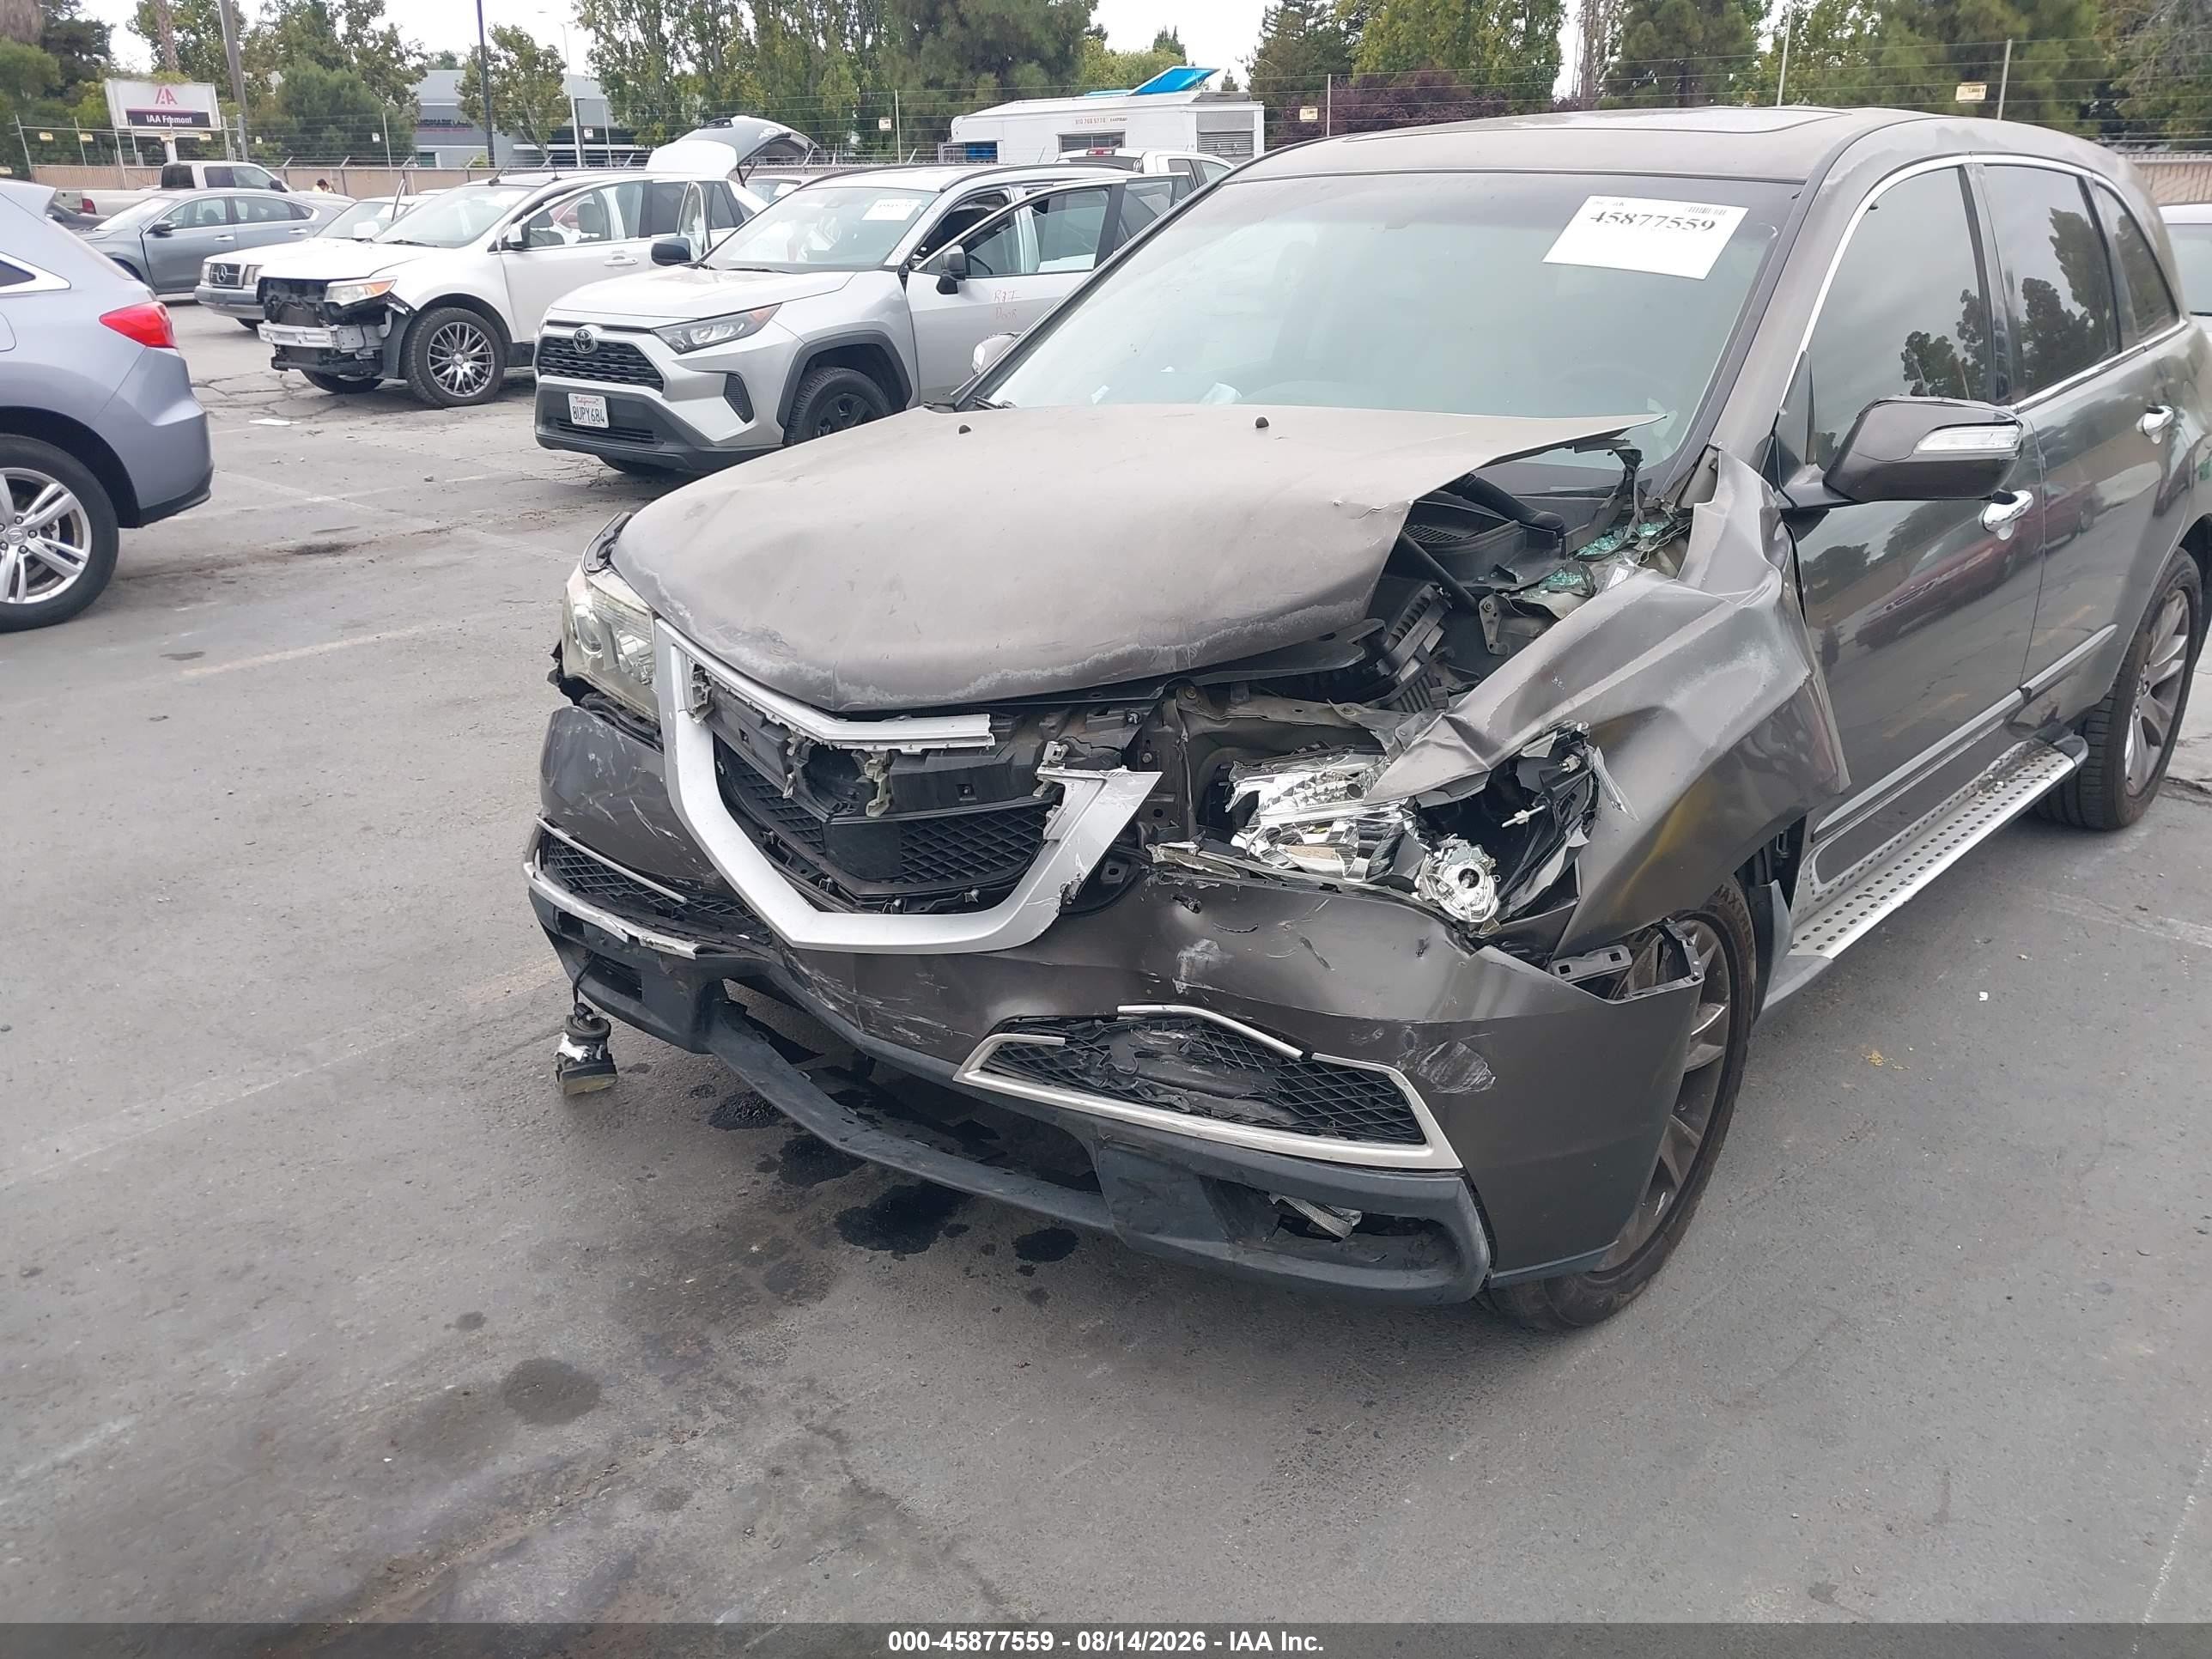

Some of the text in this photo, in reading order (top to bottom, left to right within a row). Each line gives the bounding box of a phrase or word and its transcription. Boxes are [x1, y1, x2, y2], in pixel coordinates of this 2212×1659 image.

[146, 114, 193, 124] IAA Fremont
[1590, 211, 1716, 231] 45877559
[572, 405, 605, 423] 8UPY684
